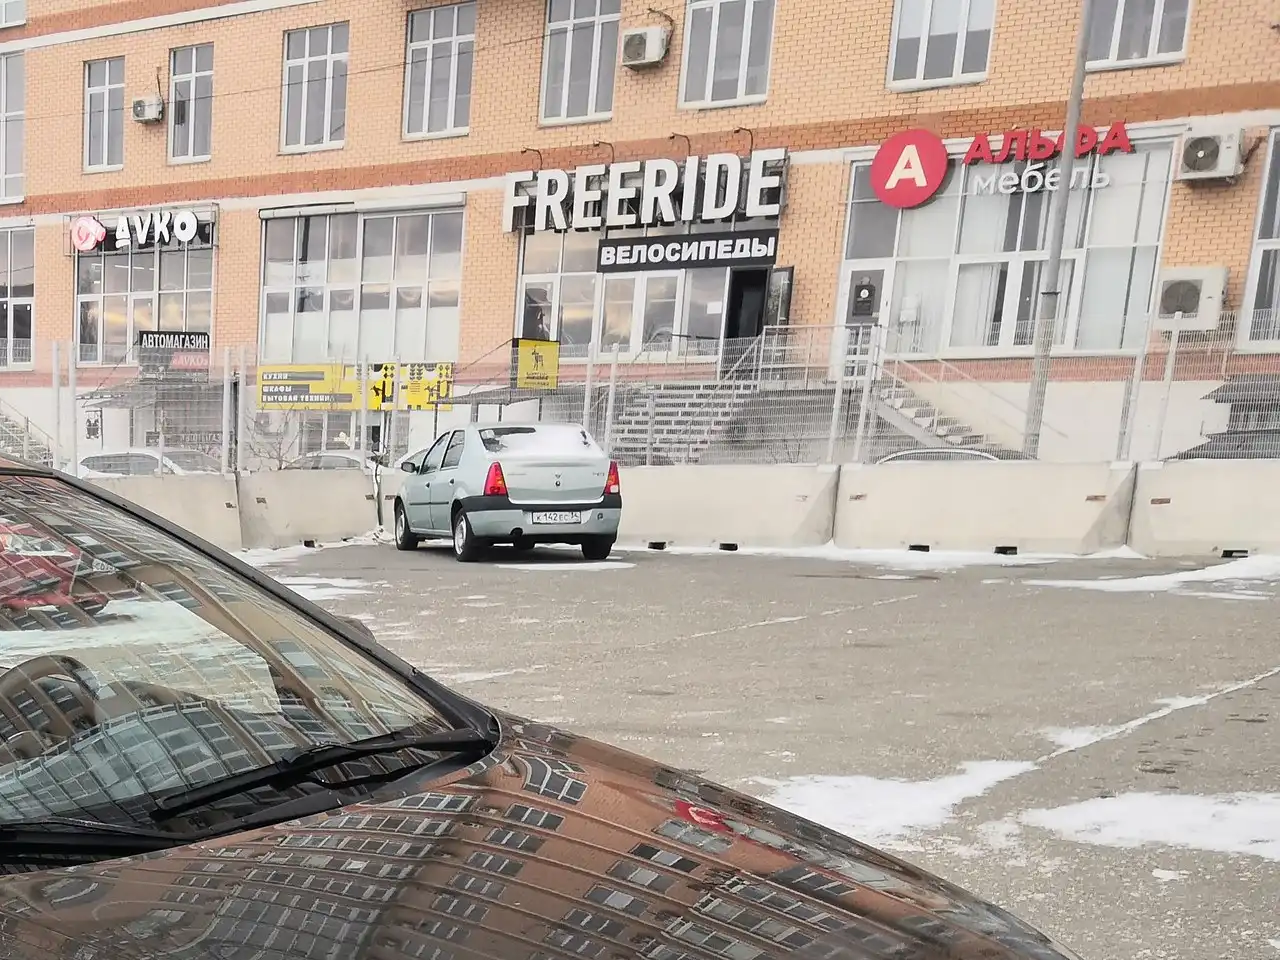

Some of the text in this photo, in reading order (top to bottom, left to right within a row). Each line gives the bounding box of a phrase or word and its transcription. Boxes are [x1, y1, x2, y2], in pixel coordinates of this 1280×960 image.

[961, 120, 1134, 165] АЛЬФА
[884, 143, 928, 190] А
[972, 162, 1111, 196] мебель
[502, 147, 787, 233] FREERIDE
[114, 210, 199, 249] AVKO
[600, 236, 776, 267] ВЕЛОСИПЕДЫ
[141, 333, 209, 349] АВТОМАГАЗИН
[262, 385, 292, 393] ШКАФЫ
[263, 372, 288, 380] КУХНИ
